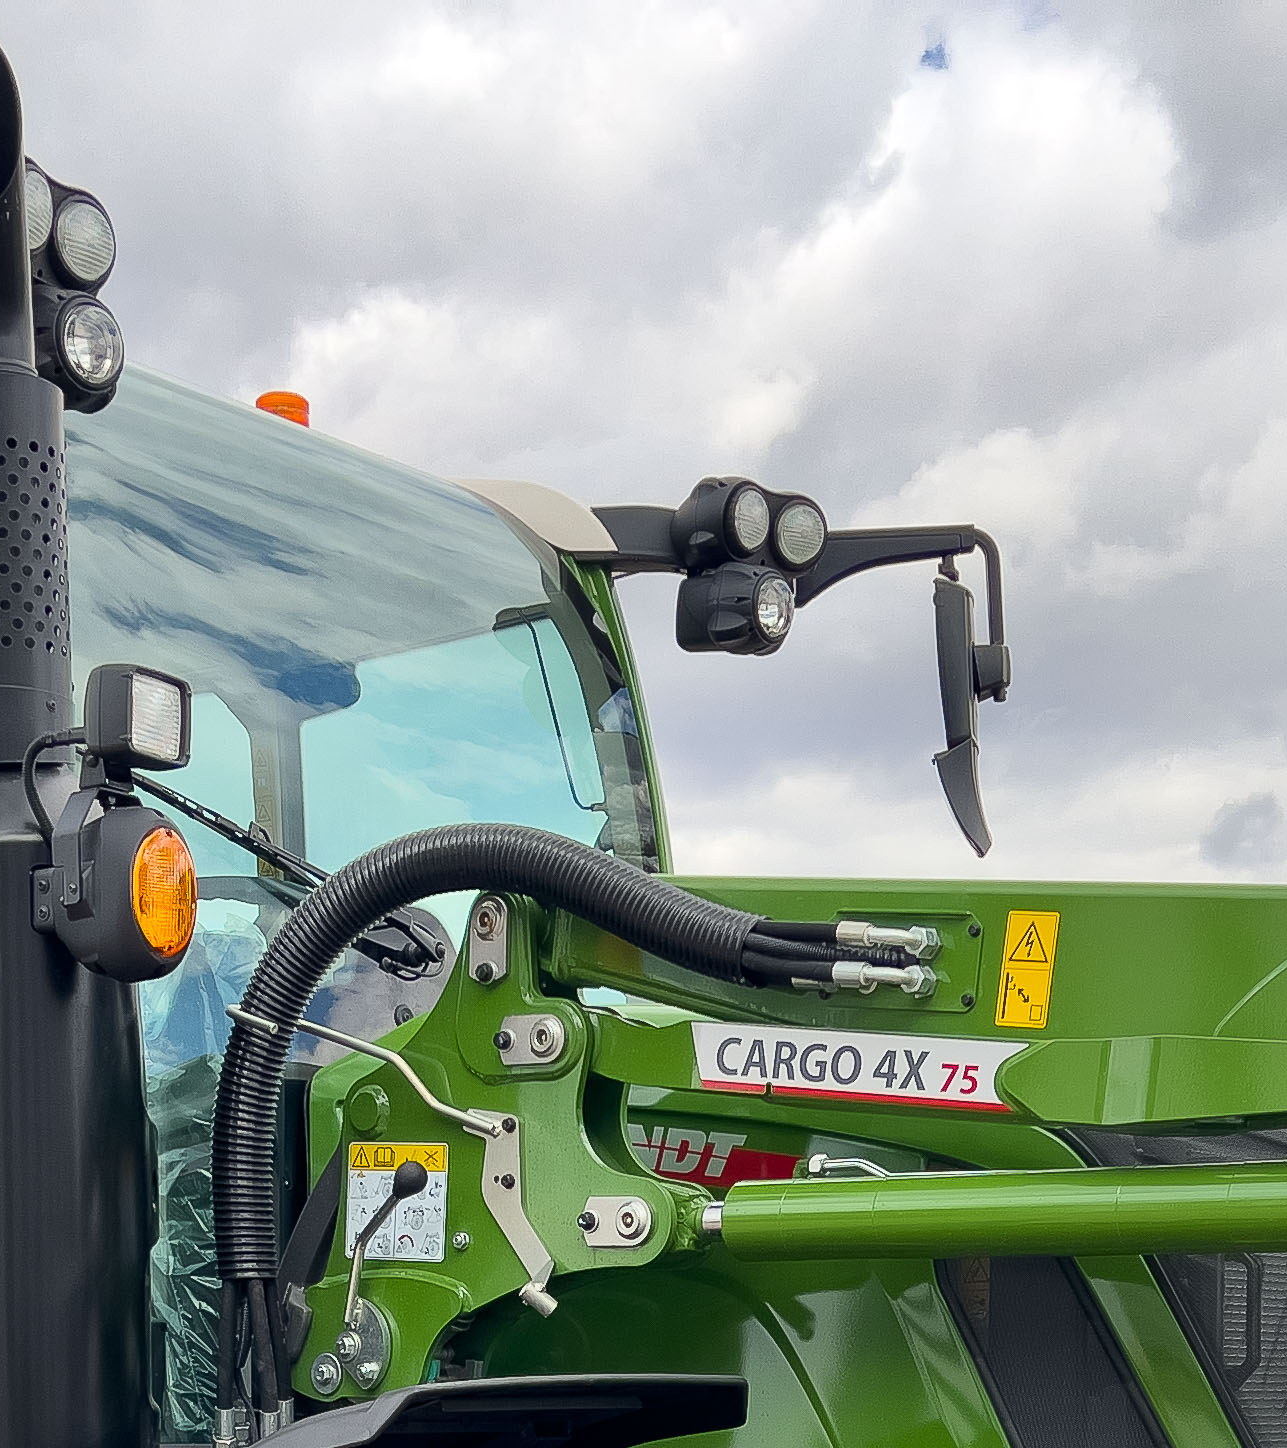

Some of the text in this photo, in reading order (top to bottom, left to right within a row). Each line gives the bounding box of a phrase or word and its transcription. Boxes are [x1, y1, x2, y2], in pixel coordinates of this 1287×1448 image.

[716, 1036, 980, 1095] CARGO 4X 75
